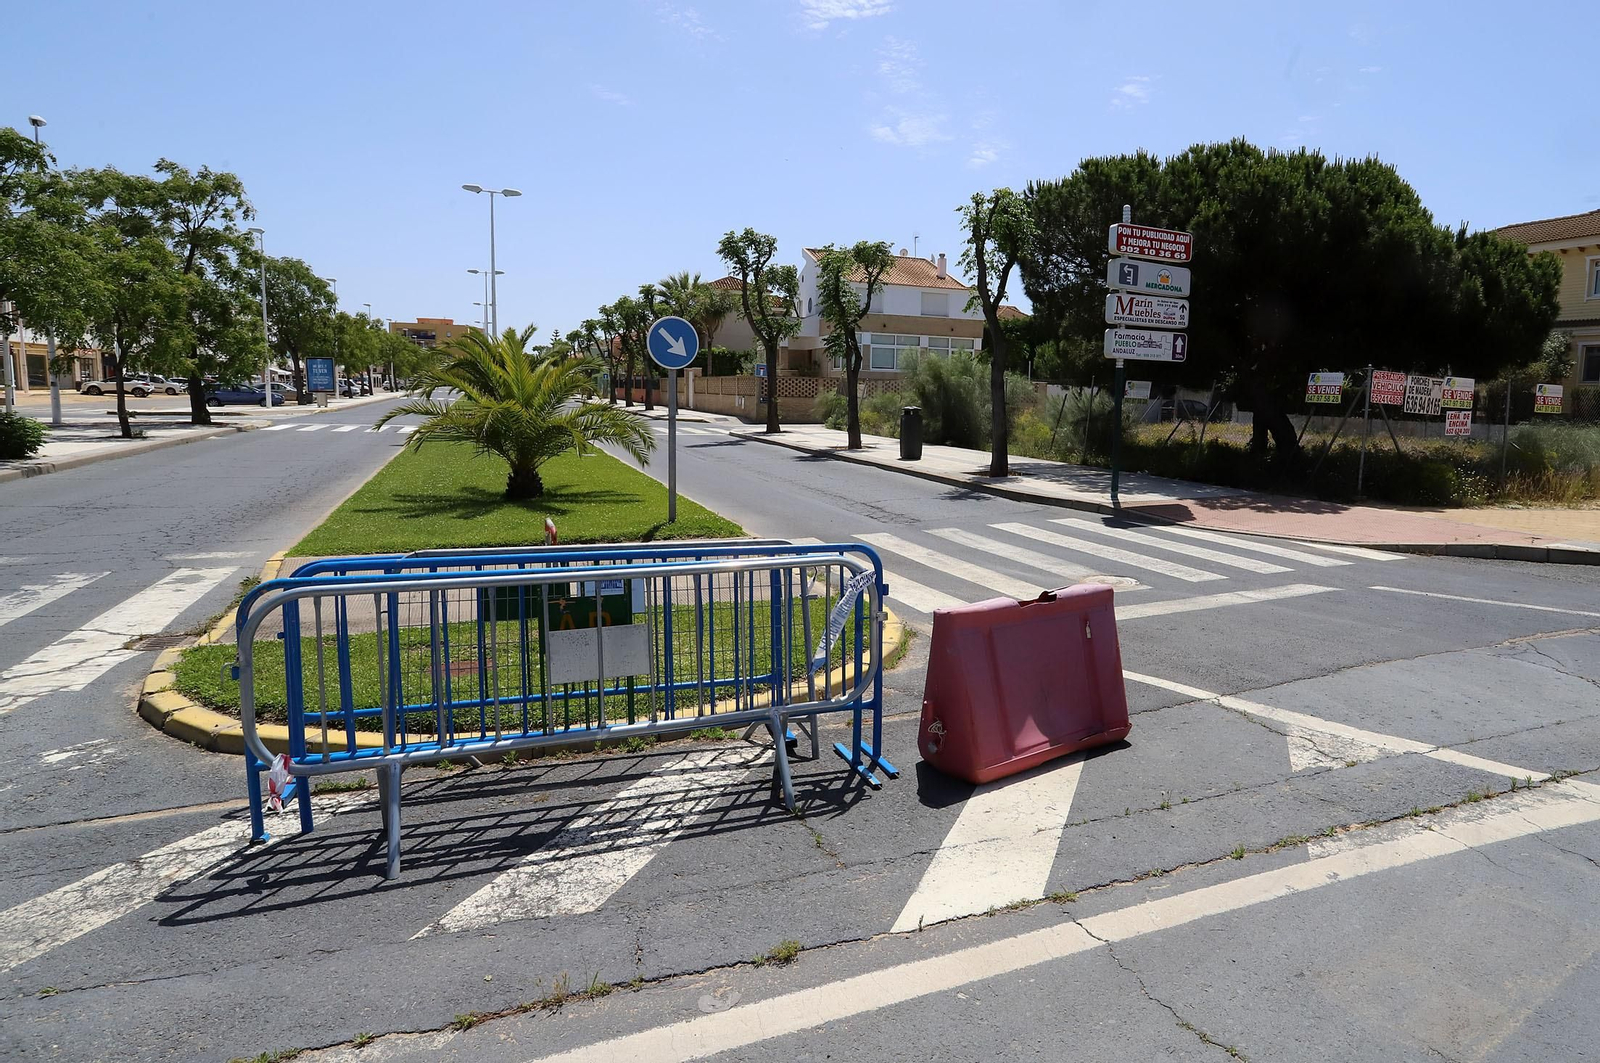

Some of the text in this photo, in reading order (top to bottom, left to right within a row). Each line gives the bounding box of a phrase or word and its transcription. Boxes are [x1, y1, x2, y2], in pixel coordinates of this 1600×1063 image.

[1118, 226, 1190, 243] PON TU PUBLICIDAD AQUÍ
[1128, 238, 1150, 248] MEJORA
[1161, 242, 1185, 252] NEGOCIO
[1120, 245, 1140, 254] 902
[1144, 248, 1156, 256] 10
[1145, 282, 1182, 292] MERCADONA
[1373, 382, 1403, 391] VEHICULO
[1411, 377, 1430, 386] PORCHES
[1308, 385, 1340, 394] SE VENDE
[1409, 386, 1414, 394] DE
[1416, 386, 1431, 396] MADERA
[1443, 390, 1472, 400] SE VENDE
[1536, 396, 1561, 406] SE VENDE
[1448, 412, 1460, 420] LEÑA
